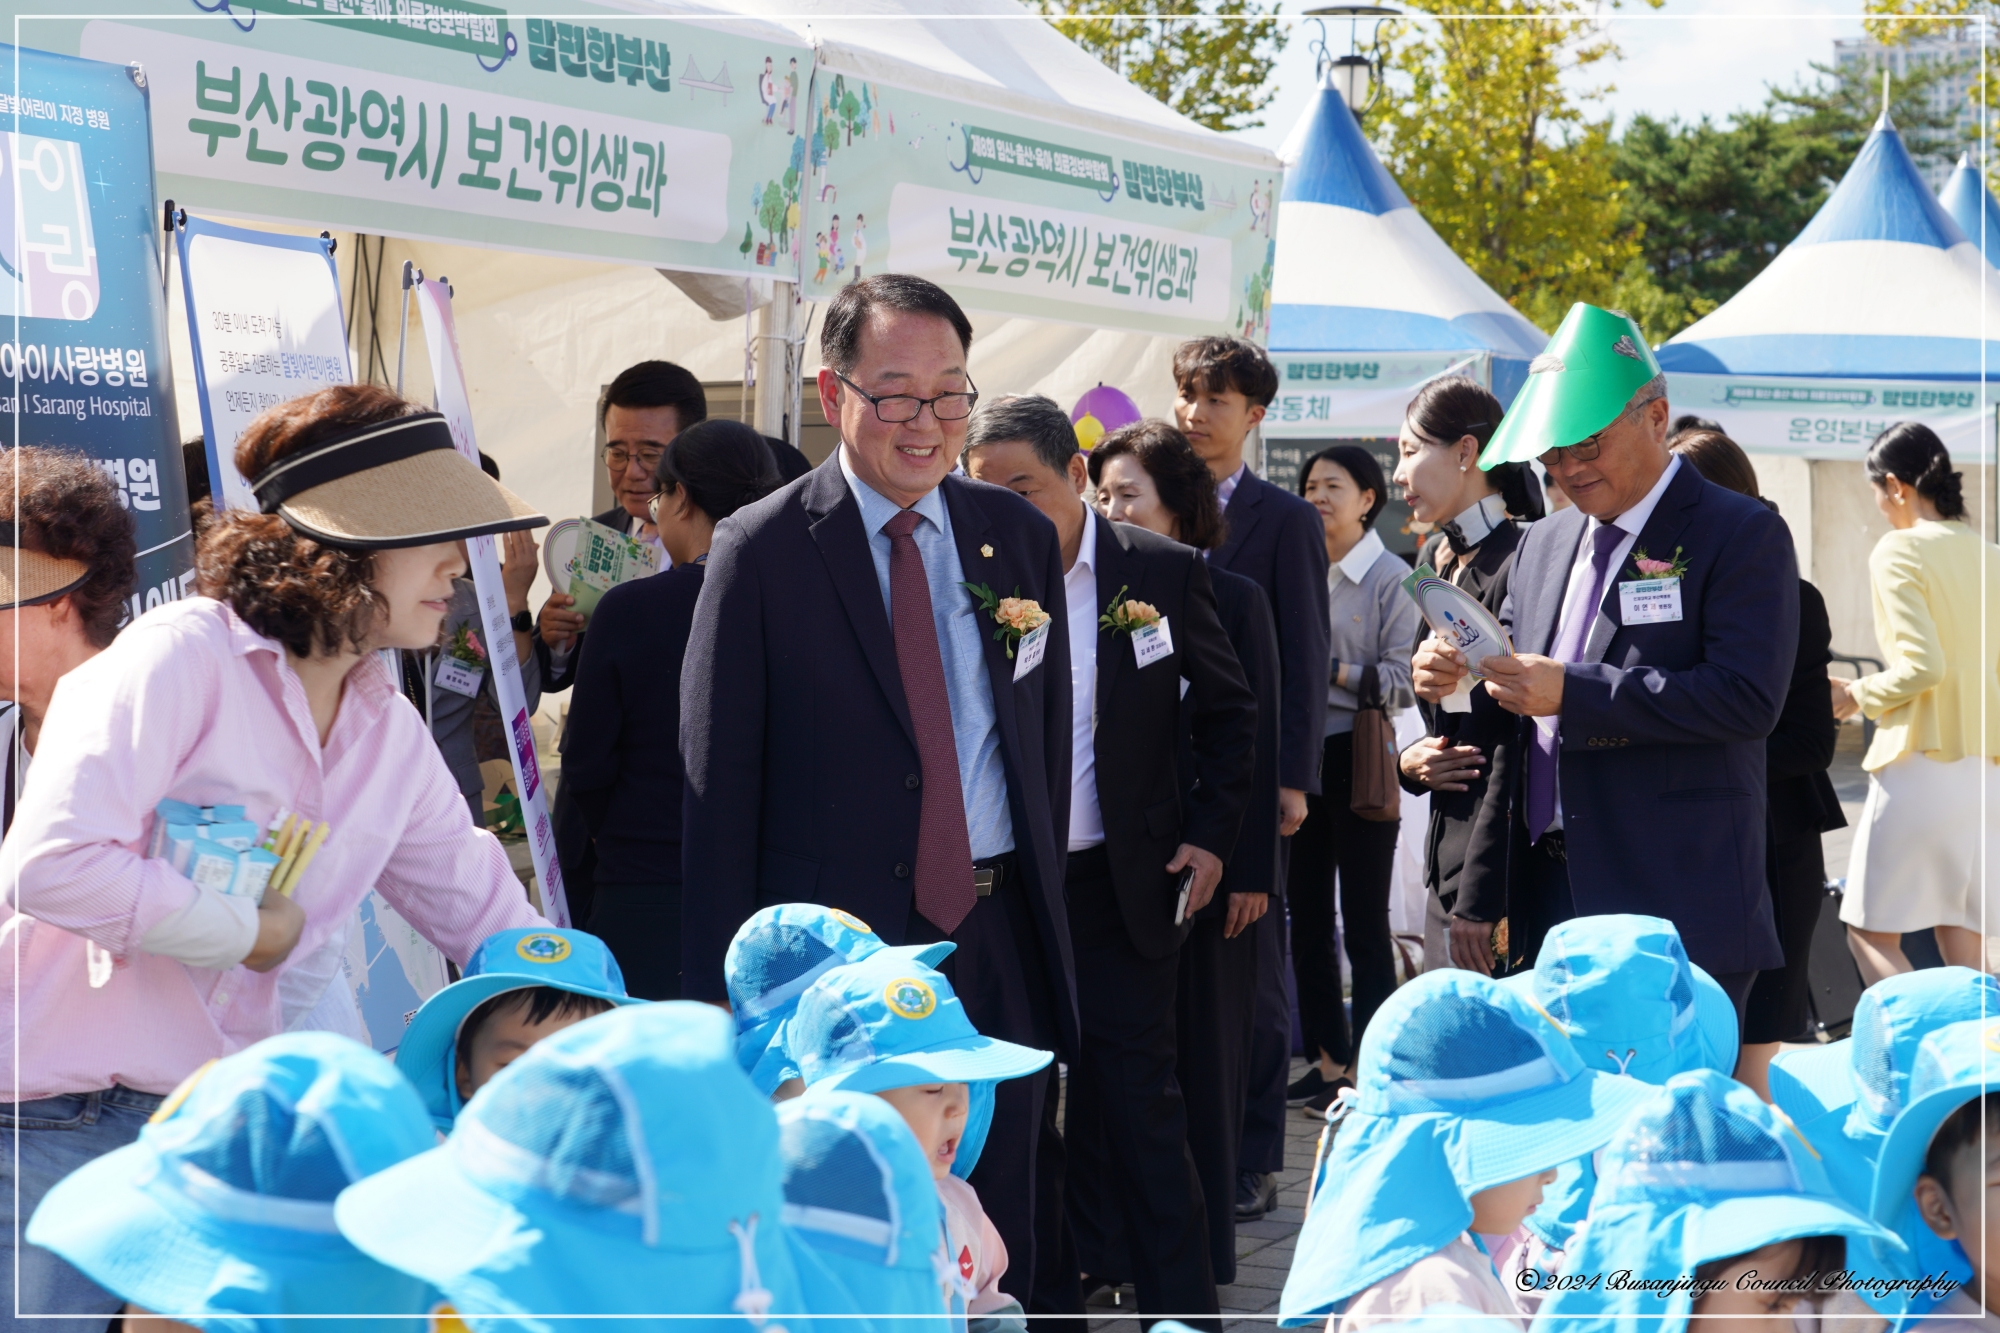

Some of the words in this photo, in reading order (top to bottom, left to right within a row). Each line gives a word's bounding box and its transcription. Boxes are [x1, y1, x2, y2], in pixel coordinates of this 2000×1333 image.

[526, 17, 672, 93] 맘편한부산
[59, 104, 84, 126] 지정
[85, 108, 110, 131] 병원
[188, 59, 449, 190] 부산광역시
[458, 111, 668, 218] 보건위생과
[970, 134, 996, 160] 제8회
[1053, 152, 1110, 184] 의료정보박람회
[1122, 160, 1206, 211] 맘편한부산
[947, 206, 1089, 288] 부산광역시
[1086, 232, 1198, 304] 보건위생과
[212, 311, 232, 333] 30분
[233, 313, 251, 335] 이내
[251, 315, 267, 337] 도착
[267, 317, 282, 339] 가능
[1, 343, 149, 388] 아이사랑병원
[219, 350, 252, 374] 공휴일도
[252, 353, 281, 377] 진료하는
[281, 352, 343, 382] 달빛어린이병원
[1287, 361, 1380, 381] 맘편한부산
[32, 394, 87, 421] Sarang
[90, 396, 152, 421] Hospital
[225, 390, 258, 413] 언제든지
[1882, 389, 1975, 408] 맘편한부산
